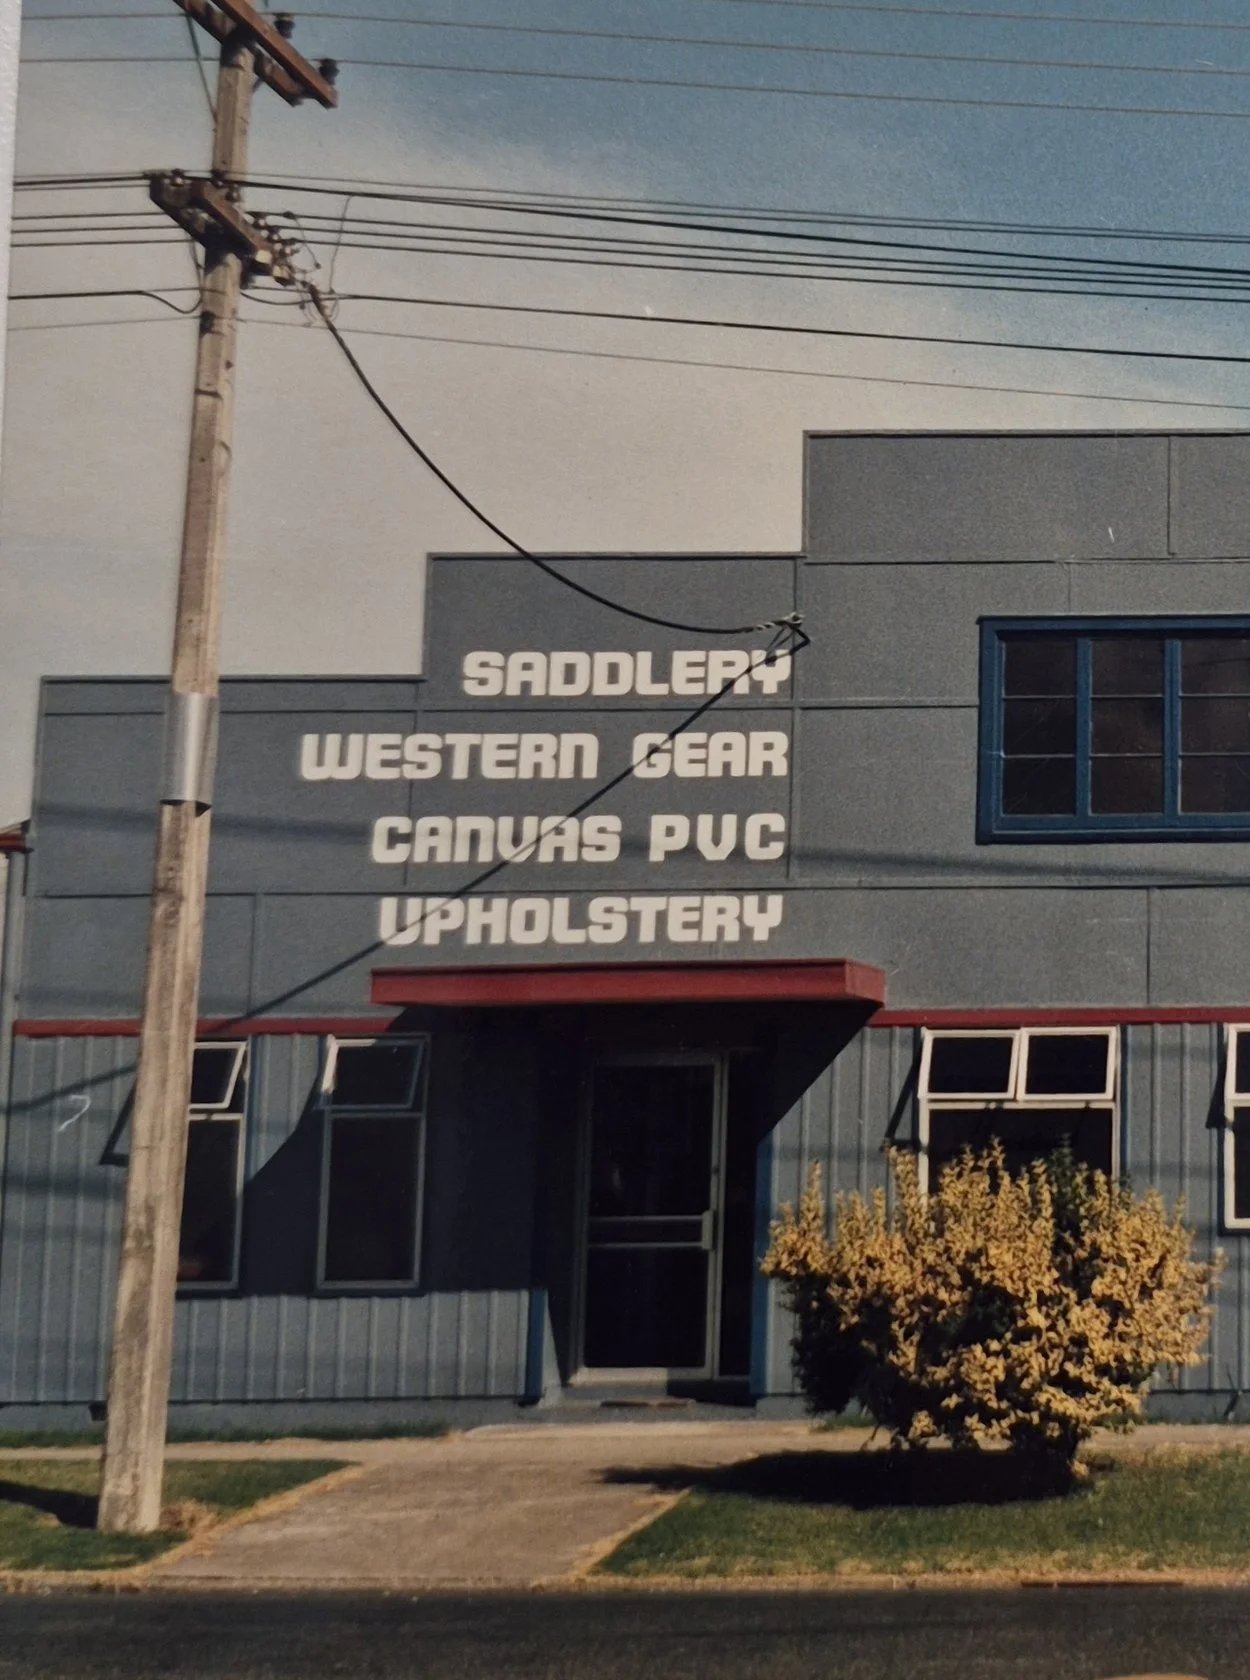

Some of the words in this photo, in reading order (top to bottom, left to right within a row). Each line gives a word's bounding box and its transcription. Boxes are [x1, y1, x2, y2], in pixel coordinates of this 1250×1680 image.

[462, 650, 791, 697] SADDLERY
[300, 733, 599, 780] WESTERN
[632, 732, 789, 778] GEAR
[371, 815, 622, 863] CANVAS
[649, 814, 785, 862] PVC
[379, 895, 784, 945] UPHOLSTERY
